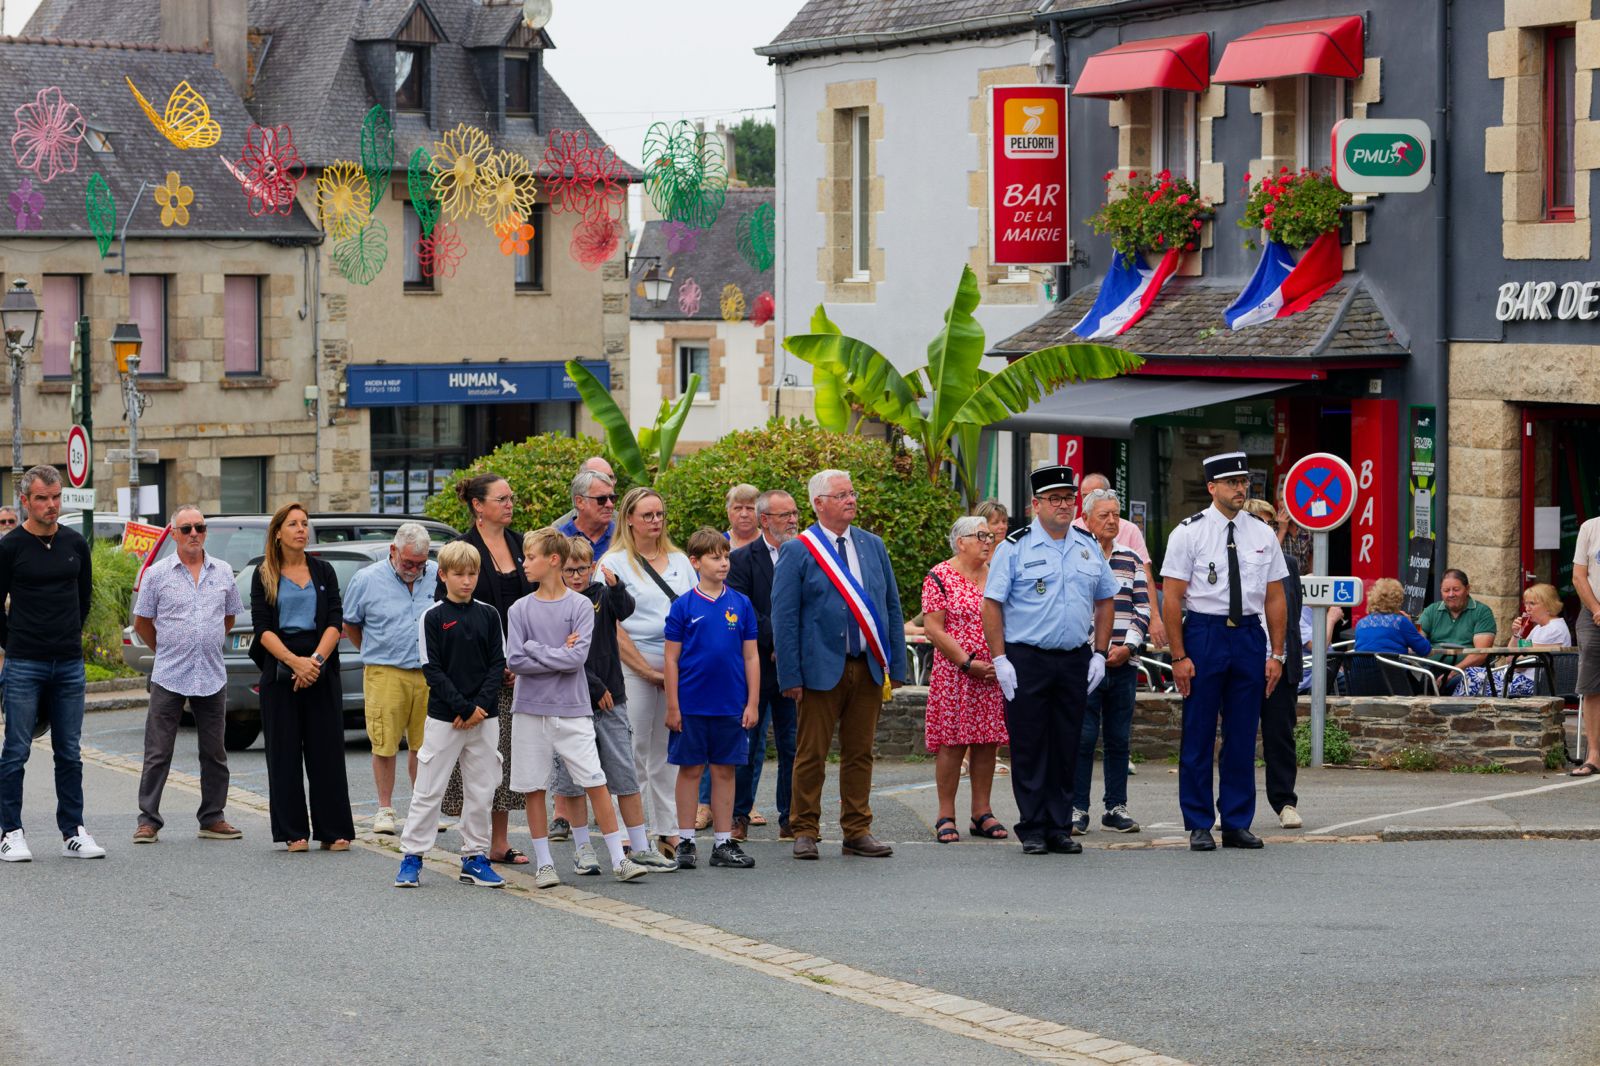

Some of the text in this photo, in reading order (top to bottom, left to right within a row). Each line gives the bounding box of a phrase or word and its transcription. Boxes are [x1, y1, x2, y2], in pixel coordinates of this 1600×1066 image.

[1011, 137, 1054, 149] PELFORTH
[1352, 148, 1391, 164] PMU
[1003, 183, 1060, 208] BAR
[1013, 211, 1053, 223] DE LA
[1002, 228, 1061, 242] MAIRIE
[1496, 281, 1600, 321] BAR DE
[449, 372, 498, 387] HUMAN
[1359, 459, 1374, 563] BAR
[1301, 584, 1329, 597] AUF
